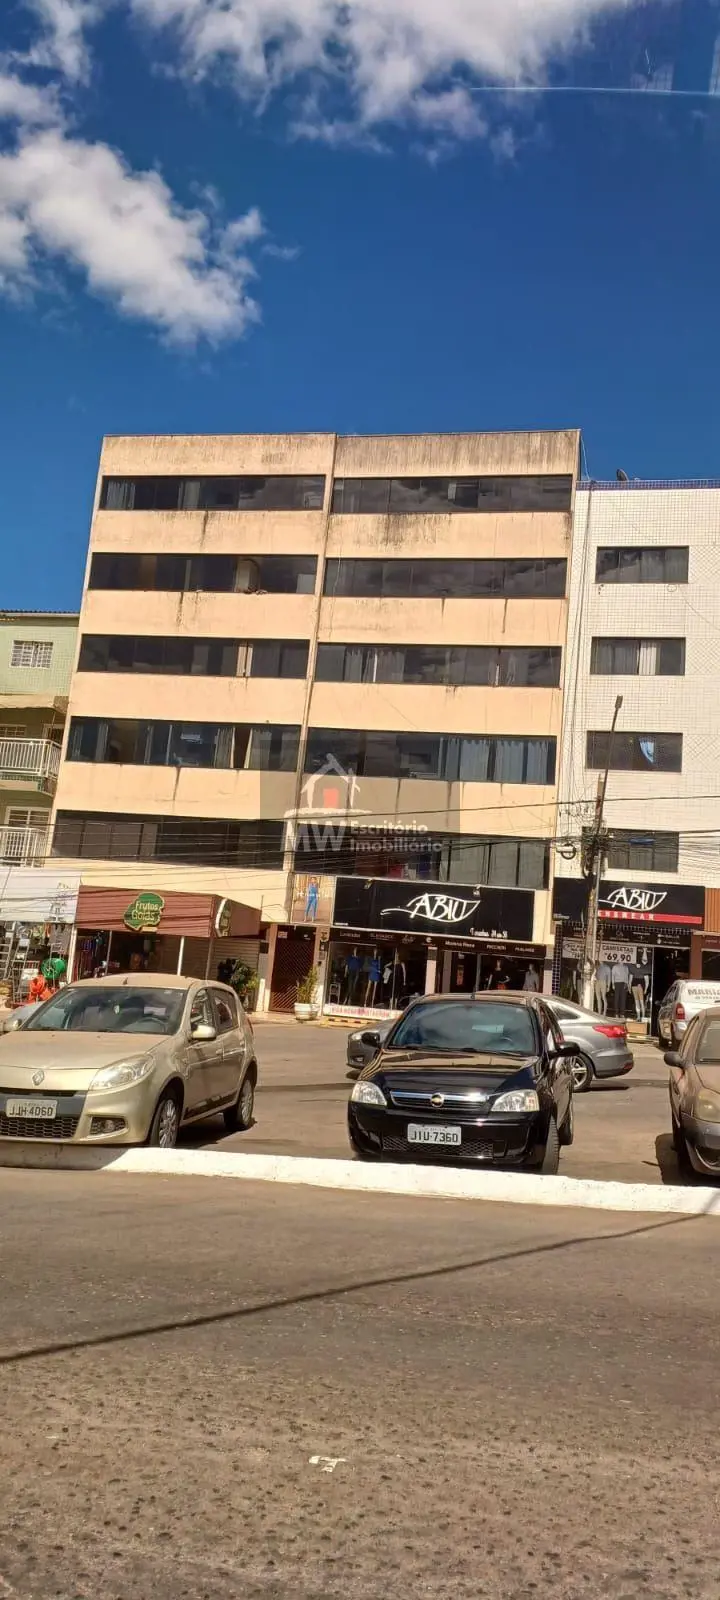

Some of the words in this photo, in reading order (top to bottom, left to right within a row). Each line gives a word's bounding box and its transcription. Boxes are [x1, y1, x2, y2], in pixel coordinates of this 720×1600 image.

[612, 887, 656, 911] ABIU
[135, 900, 160, 911] Frutos
[409, 893, 468, 920] ABIU
[598, 910, 655, 920] ENSWEAR
[602, 945, 634, 954] CAMISETAS
[411, 1130, 458, 1142] JIU-7360
